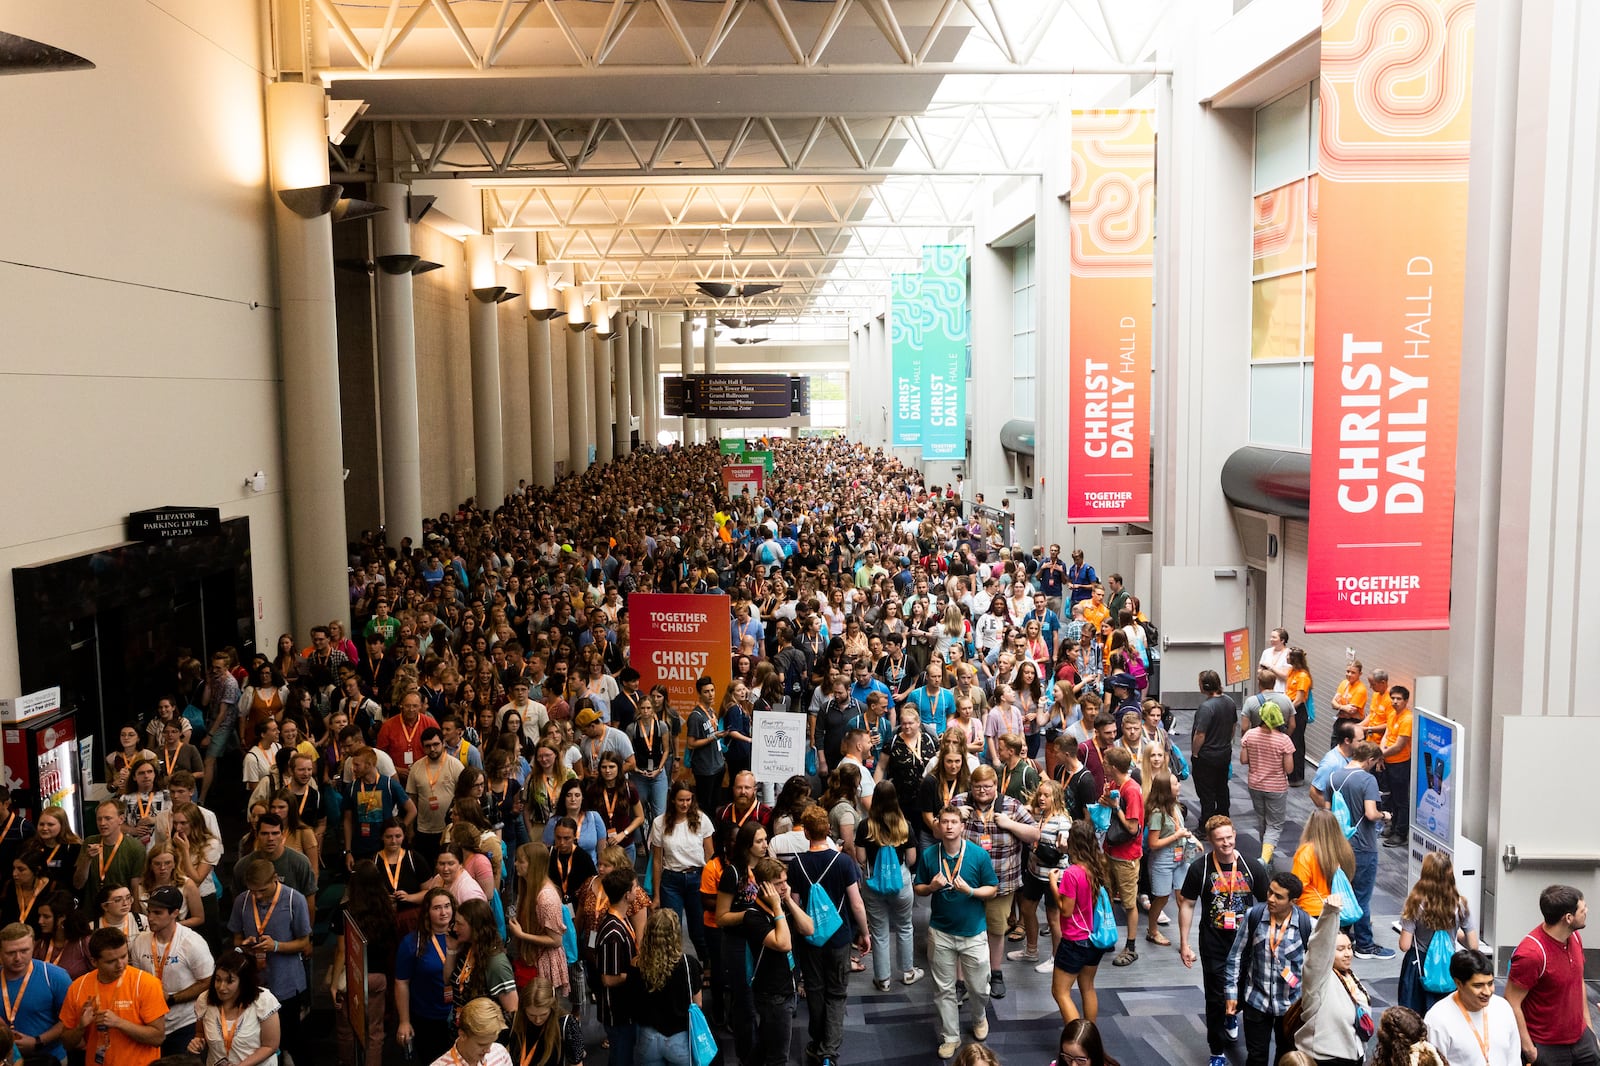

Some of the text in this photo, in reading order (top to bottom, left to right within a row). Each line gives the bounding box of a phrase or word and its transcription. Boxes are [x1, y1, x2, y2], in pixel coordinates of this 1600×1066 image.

[950, 361, 958, 382] HALL
[1110, 316, 1136, 459] DAILY HALL D
[1384, 255, 1433, 515] DAILY HALL D
[793, 389, 798, 399] 1
[899, 377, 910, 420] CHRIST
[931, 374, 943, 426] CHRIST
[910, 385, 921, 420] DAILY
[944, 383, 957, 427] DAILY
[1084, 358, 1109, 459] CHRIST
[1337, 332, 1383, 514] CHRIST
[1084, 491, 1132, 501] TOGETHER
[1092, 500, 1127, 509] CHRIST
[143, 519, 209, 530] PARKING LEVELS
[155, 512, 196, 521] ELEVATOR
[1336, 575, 1421, 591] TOGETHER
[1337, 590, 1409, 606] IN CHRIST
[650, 612, 708, 623] TOGETHER
[660, 622, 700, 633] CHRIST
[652, 650, 709, 666] CHRIST
[657, 666, 705, 681] DAILY
[668, 686, 694, 694] HALL D
